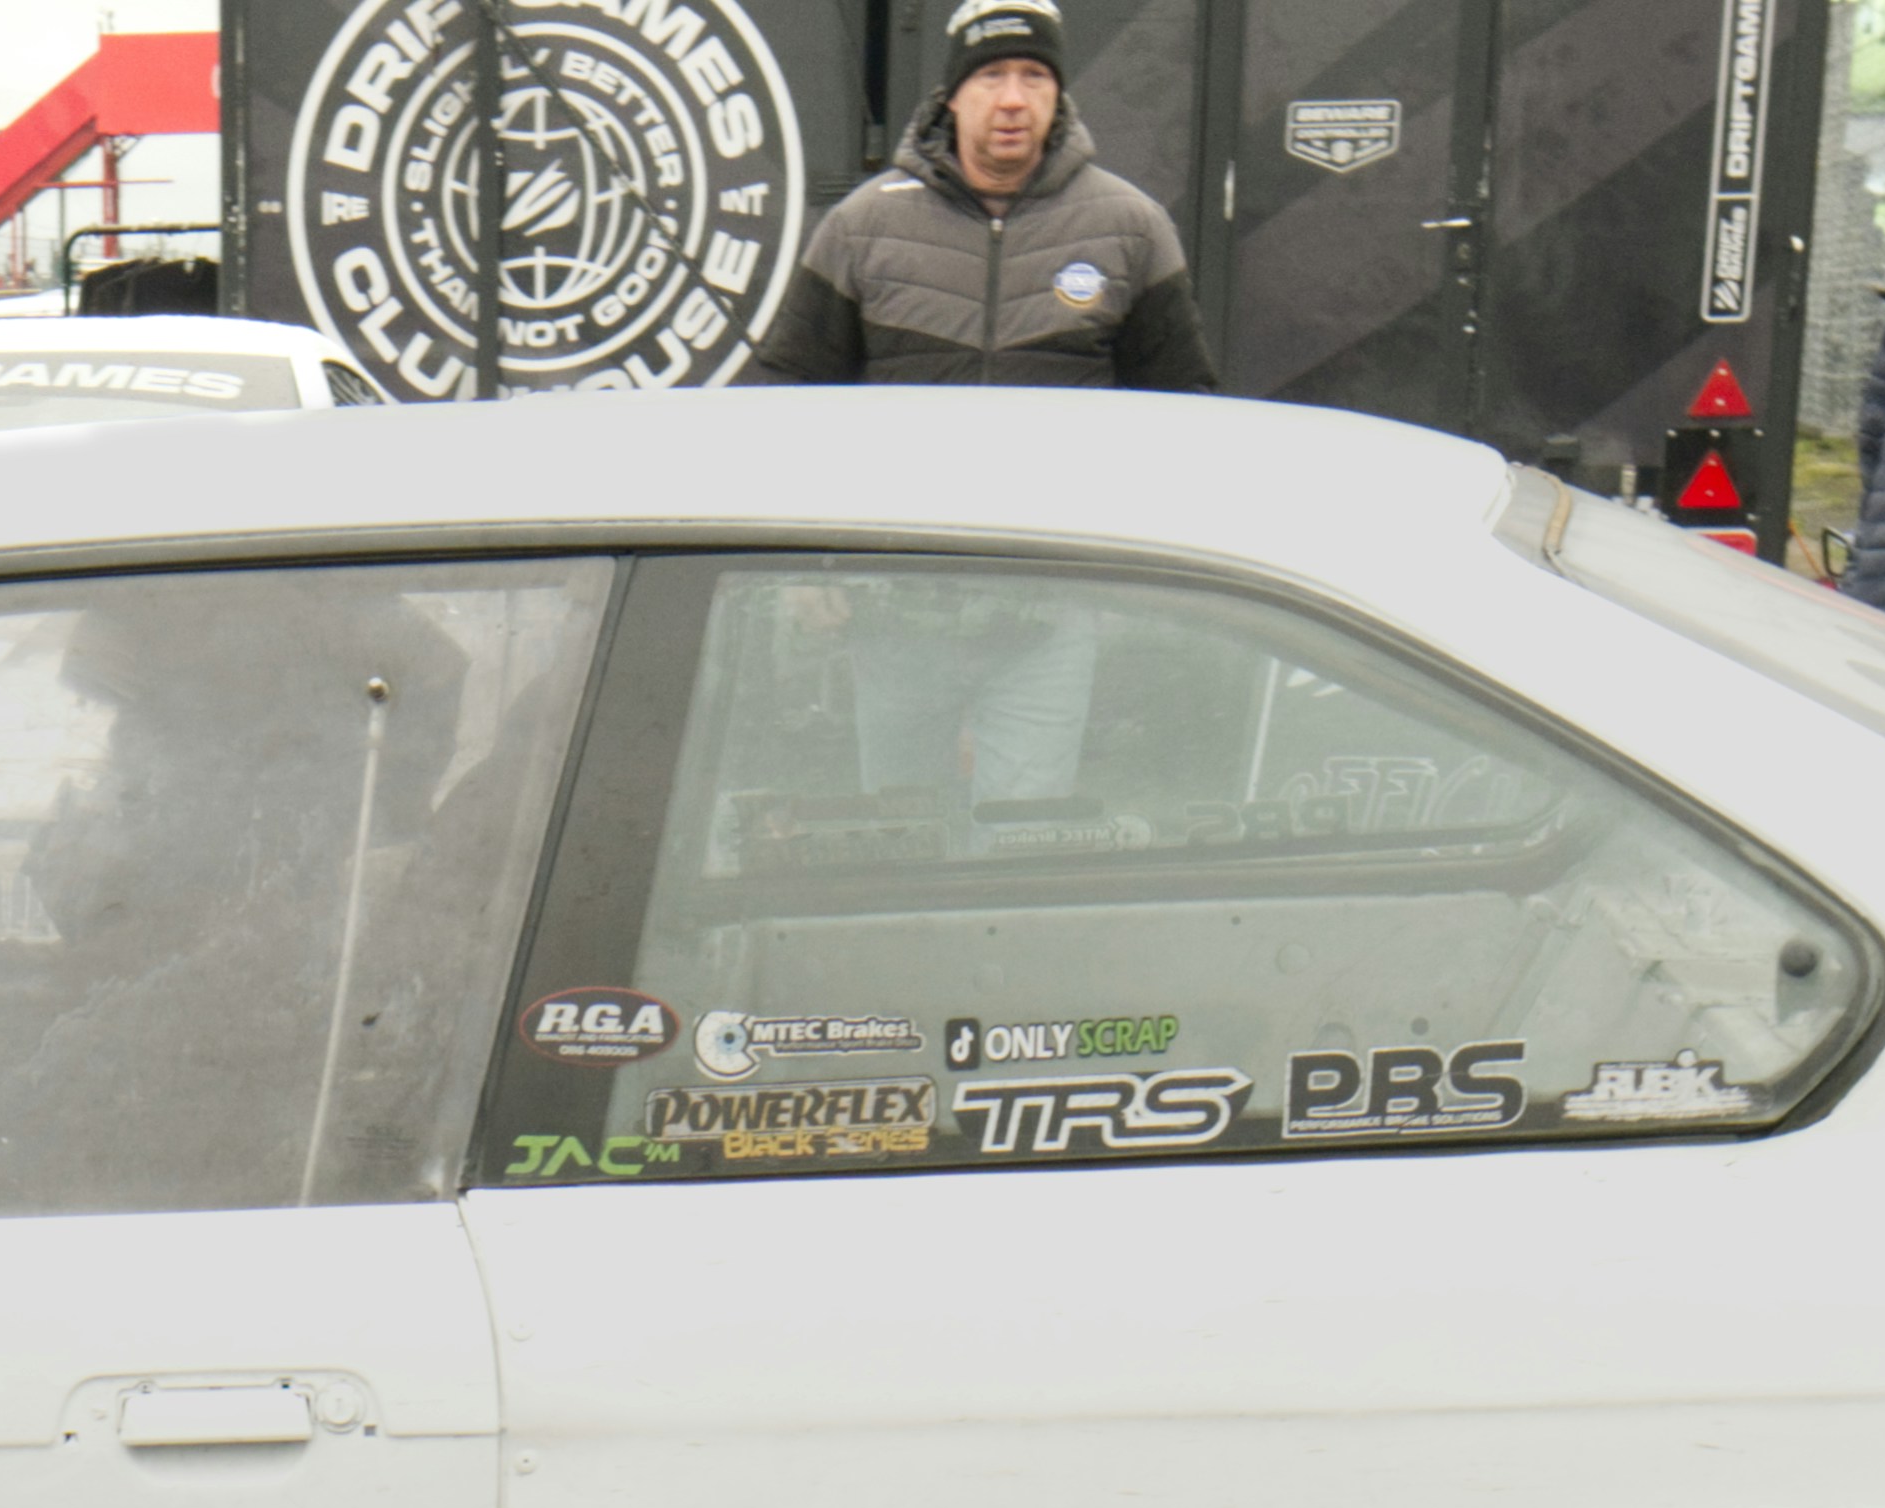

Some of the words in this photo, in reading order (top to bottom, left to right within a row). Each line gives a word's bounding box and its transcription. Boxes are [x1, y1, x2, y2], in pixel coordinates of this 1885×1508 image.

[1724, 0, 1763, 178] DRIFTGAM
[560, 50, 684, 186] BETTER
[321, 191, 370, 226] IRE
[719, 182, 769, 216] INT
[497, 312, 586, 347] NOT
[536, 1002, 665, 1035] R.G.A
[752, 1022, 824, 1042] MTEC
[826, 1020, 911, 1040] Brakes
[985, 1021, 1074, 1061] ONLY
[1077, 1016, 1179, 1058] SCRAP
[1283, 1039, 1529, 1133] PBS
[649, 1083, 933, 1138] POWERFLEX
[952, 1067, 1255, 1152] TRS
[722, 1129, 815, 1159] Black
[825, 1126, 930, 1156] Series
